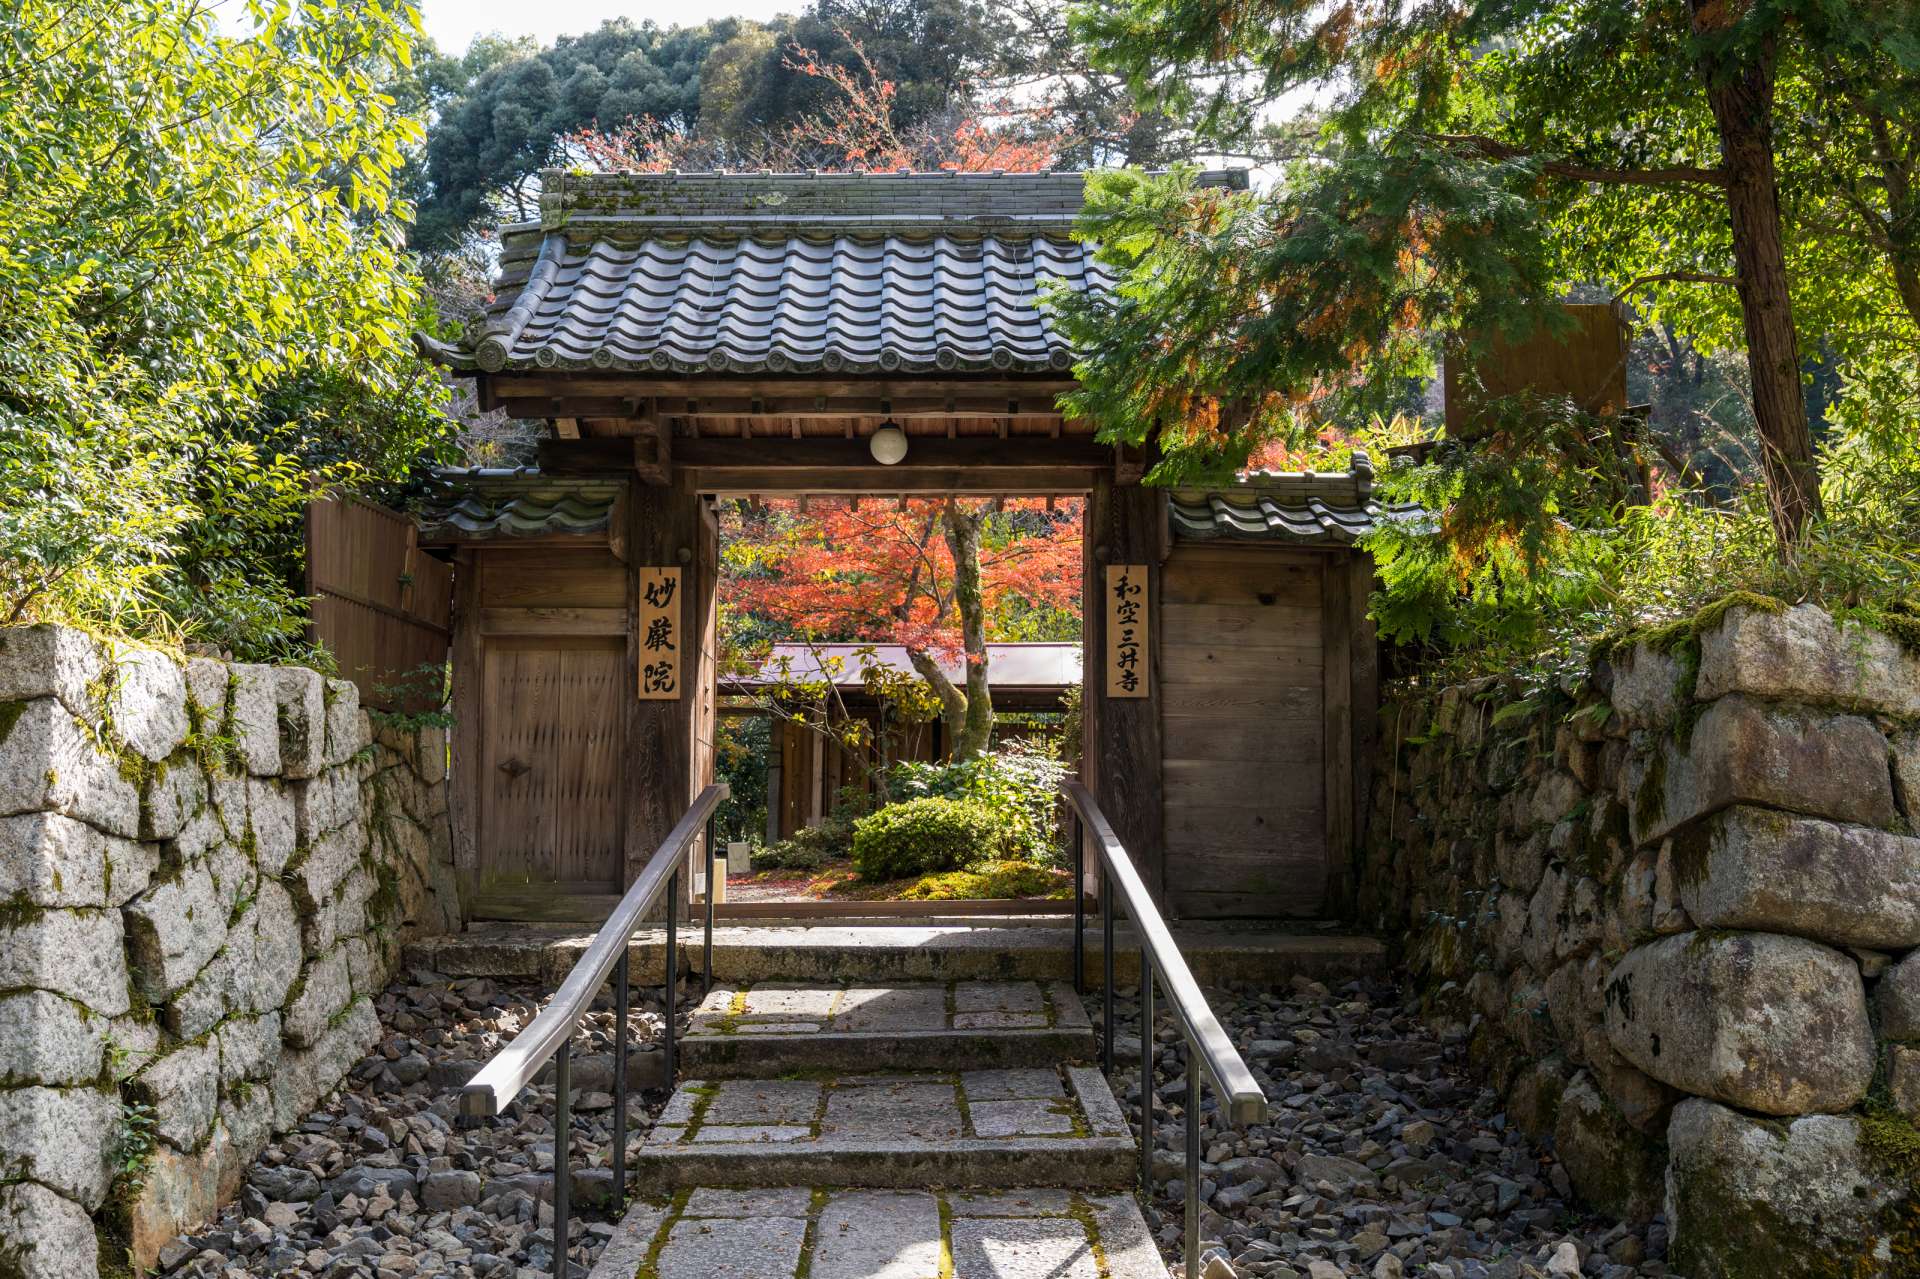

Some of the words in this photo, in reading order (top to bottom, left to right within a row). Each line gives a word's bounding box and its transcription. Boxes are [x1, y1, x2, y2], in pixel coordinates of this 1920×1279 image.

[644, 577, 676, 693] 妙厳院
[1113, 575, 1141, 692] 和空三井寺
